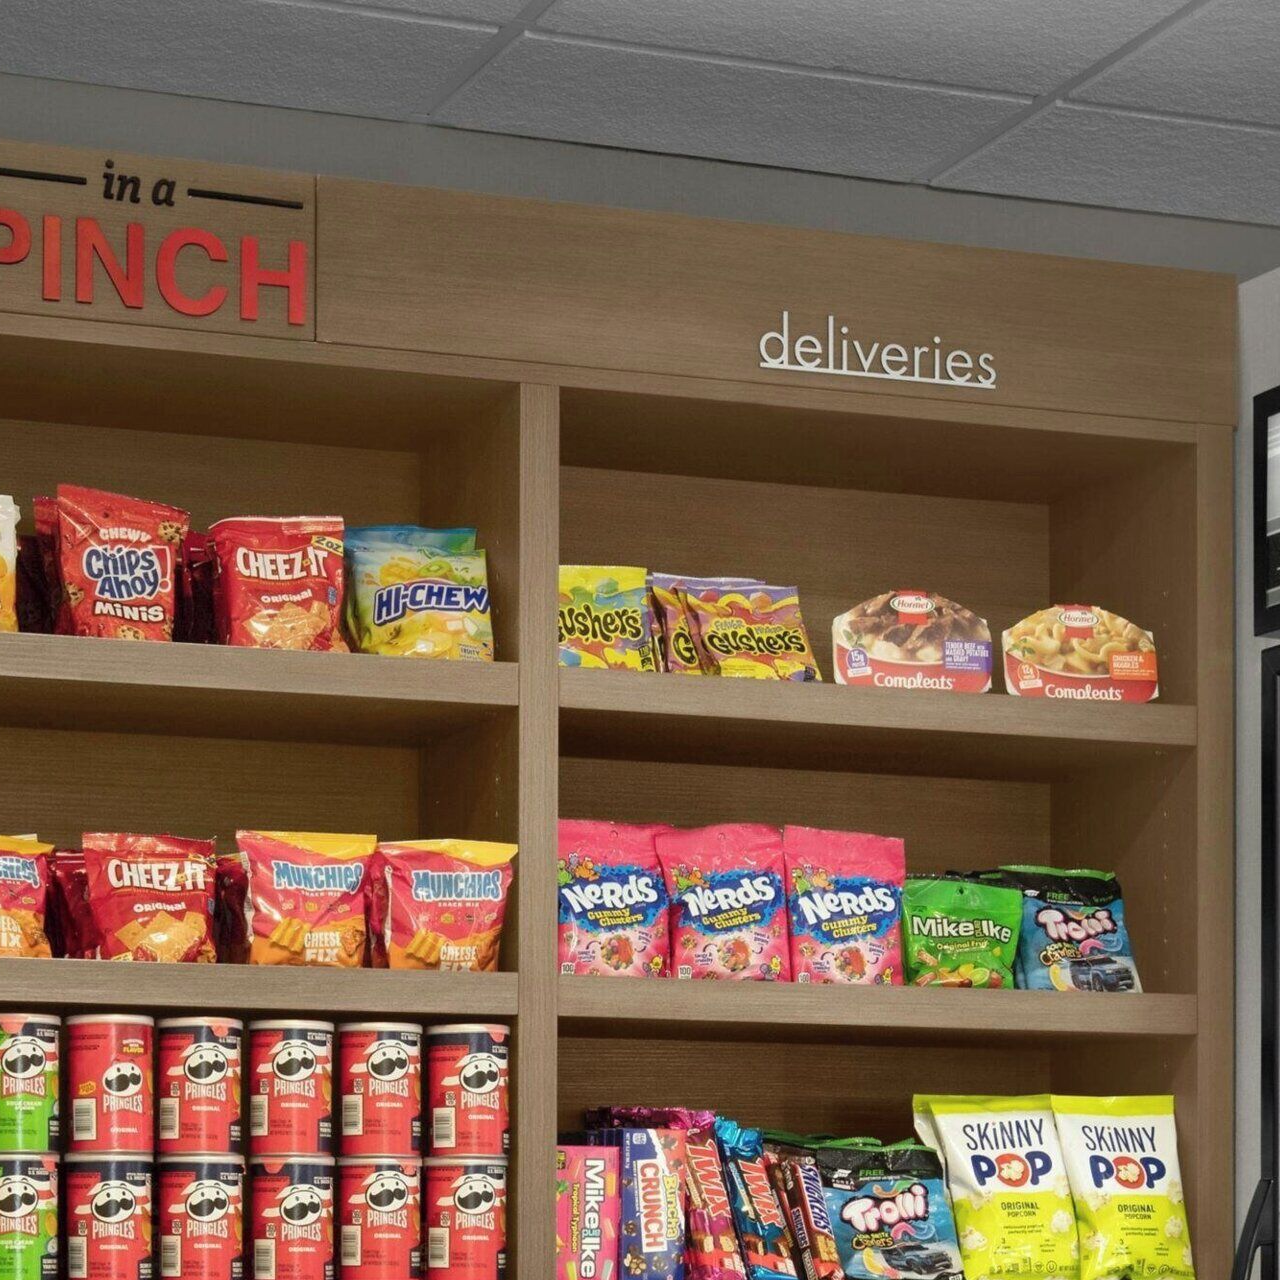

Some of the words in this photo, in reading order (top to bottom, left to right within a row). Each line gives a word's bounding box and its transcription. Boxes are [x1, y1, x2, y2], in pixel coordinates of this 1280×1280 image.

[102, 160, 140, 203] in
[151, 176, 176, 207] a
[759, 311, 996, 389] deliveries
[99, 528, 152, 543] CHEWY
[86, 550, 154, 576] Chips
[236, 548, 328, 582] CHEEZ-IT
[375, 585, 488, 625] HI-CHEW
[897, 600, 929, 609] Hormel
[1064, 613, 1094, 623] Hormel
[709, 627, 806, 655] Gushers
[874, 673, 953, 689] Compleats
[1045, 684, 1122, 700] Compleats
[107, 858, 207, 891] CHEEZ-IT
[272, 861, 363, 894] MUNCHIES
[412, 870, 502, 901] MUNCHIES
[587, 907, 630, 923] Gummy
[599, 913, 643, 928] Clusters
[911, 916, 974, 938] Mike
[982, 919, 1012, 944] Ike
[305, 948, 339, 962] FIX
[2, 1075, 47, 1098] PRINGLES
[184, 1082, 227, 1101] PRINGLES
[273, 1078, 315, 1098] PRINGLES
[368, 1078, 410, 1098] PRINGLES
[102, 1093, 144, 1113] PRINGLES
[460, 1090, 500, 1110] PRINGLES
[686, 1140, 733, 1218] TWIX
[971, 1151, 1053, 1187] POP
[1089, 1155, 1166, 1189] POP
[738, 1157, 782, 1226] TWIX
[801, 1165, 832, 1233] SNICKERS
[640, 1162, 668, 1251] CRUNCH
[663, 1174, 680, 1239] Buncha
[842, 1185, 928, 1228] Trolli
[1001, 1201, 1040, 1210] ORIGINAL
[1117, 1204, 1156, 1213] ORIGINAL
[91, 1218, 135, 1240] PRINGLES
[185, 1218, 228, 1239] PRINGLES
[366, 1209, 408, 1229] PRINGLES
[454, 1211, 495, 1231] PRINGLES
[281, 1223, 322, 1243] PRINGLES
